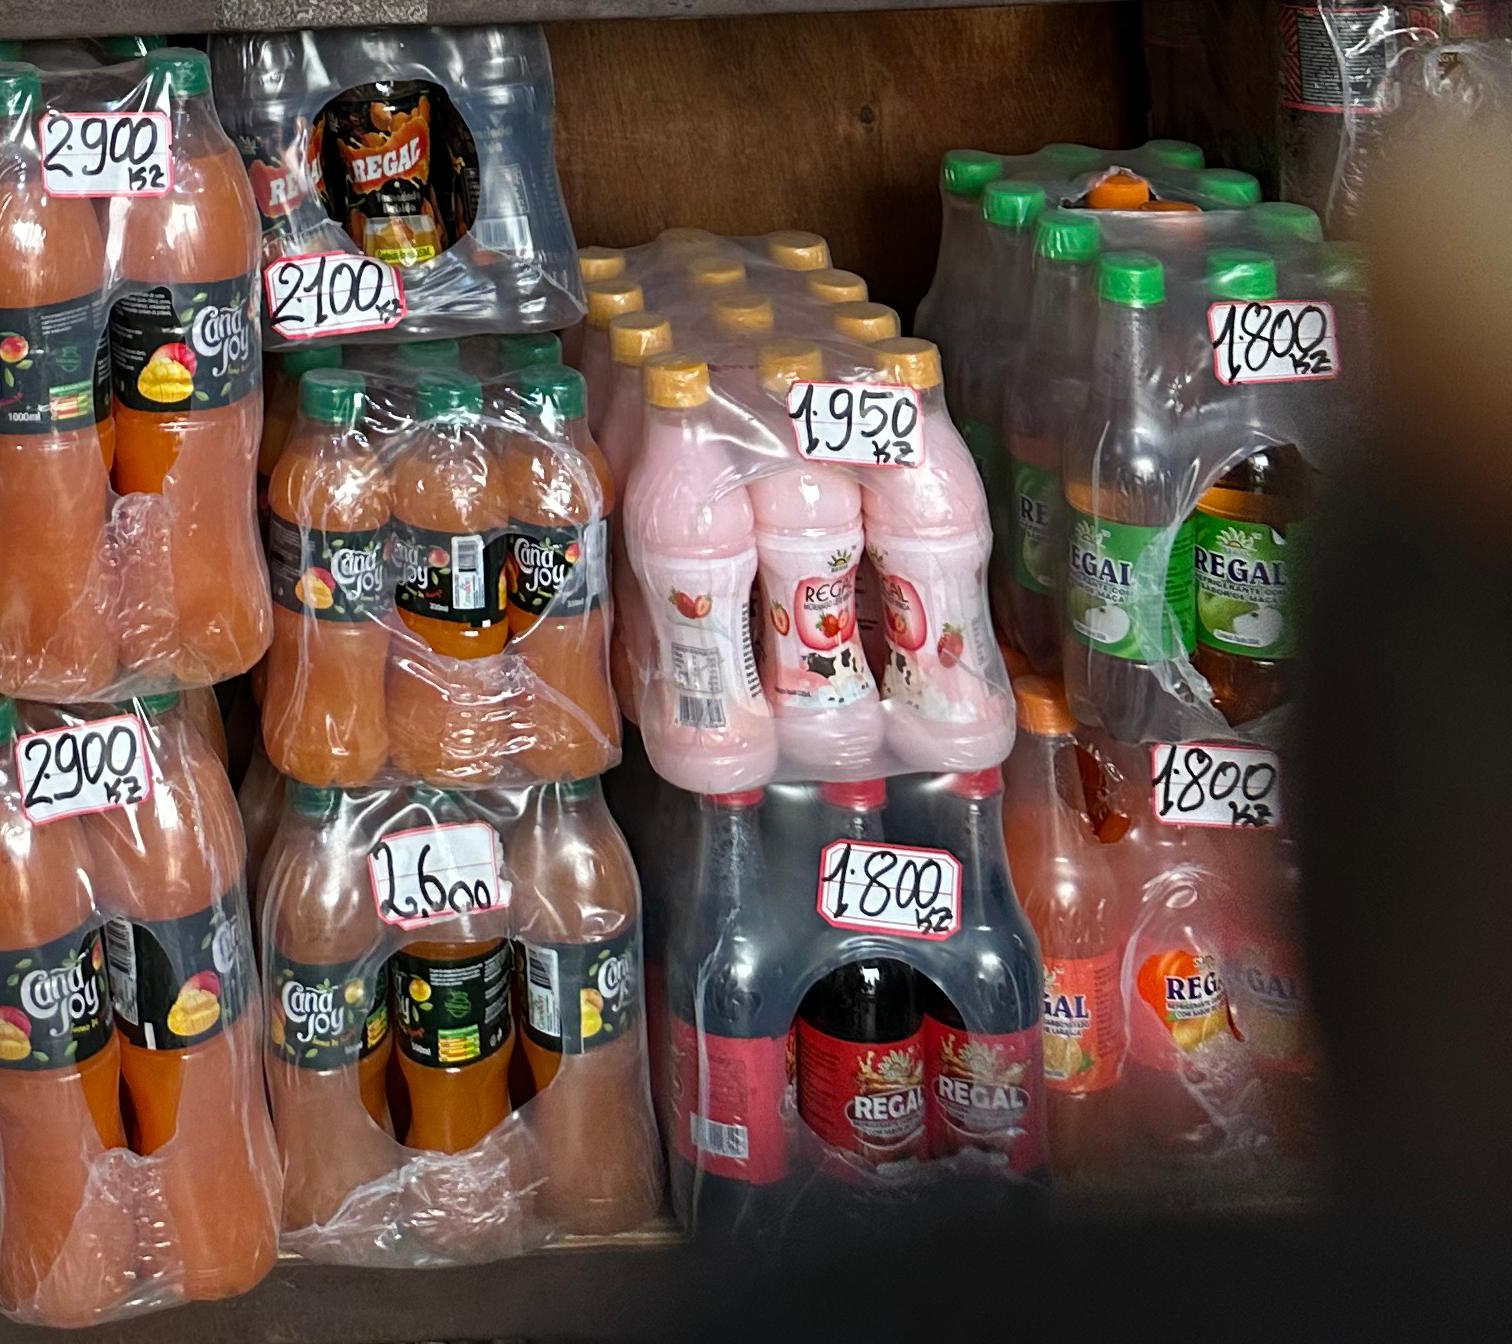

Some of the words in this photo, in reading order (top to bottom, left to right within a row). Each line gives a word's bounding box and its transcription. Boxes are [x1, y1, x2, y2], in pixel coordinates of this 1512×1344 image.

[42, 115, 159, 177] 2.900
[351, 135, 424, 182] REGAL
[272, 255, 386, 327] 2.100
[1211, 301, 1328, 385] 1.800
[787, 382, 919, 457] 1.950
[23, 724, 138, 807] 2.900
[1152, 744, 1278, 818] 1.800
[821, 842, 943, 919] 1.800
[936, 1078, 1025, 1110] REGAL
